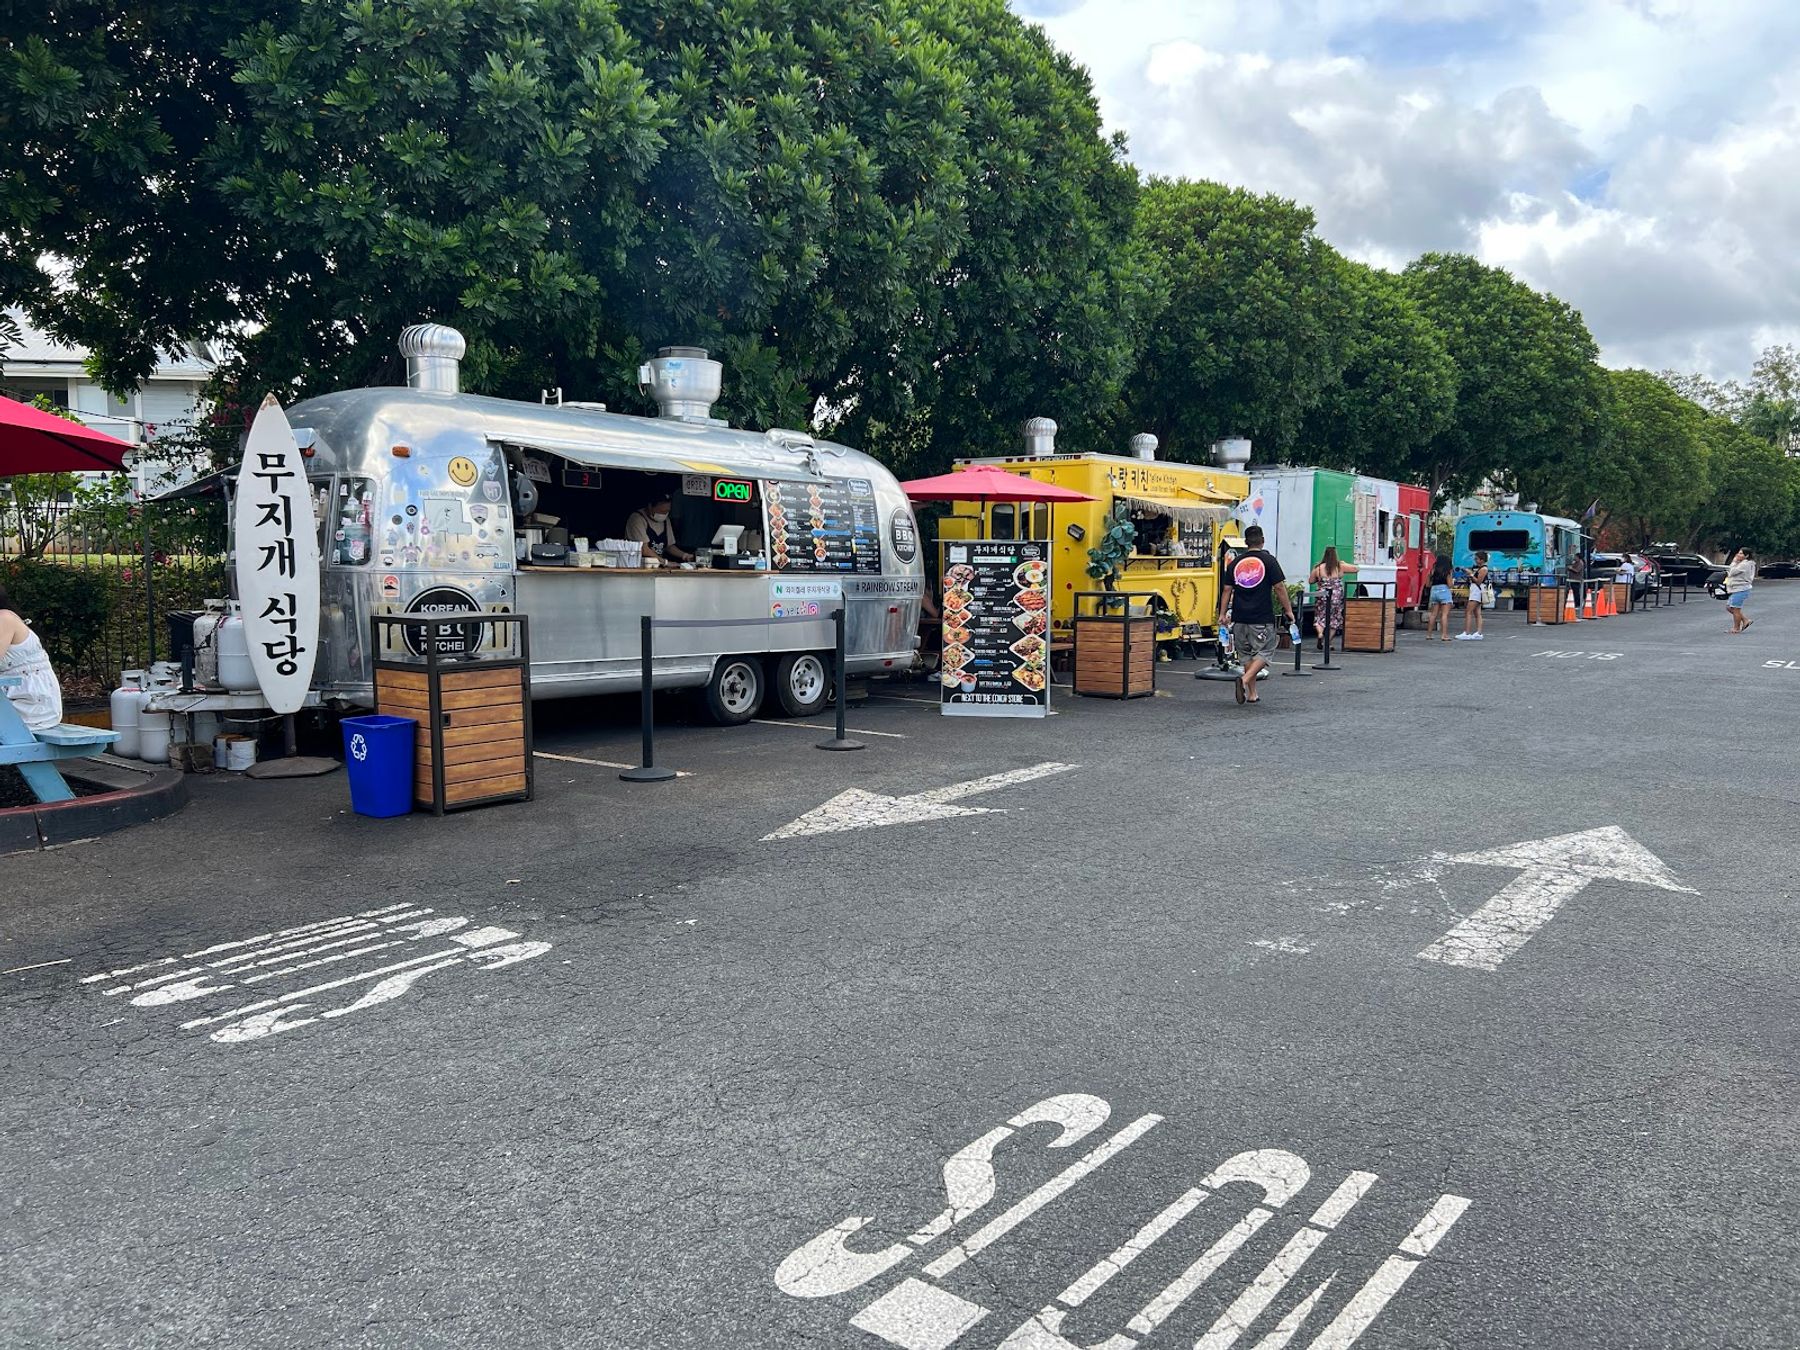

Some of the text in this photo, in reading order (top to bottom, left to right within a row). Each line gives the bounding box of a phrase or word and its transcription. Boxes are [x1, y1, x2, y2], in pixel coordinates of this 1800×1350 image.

[717, 482, 750, 499] OPEN
[861, 581, 894, 594] RAINBOW
[895, 582, 919, 594] STREAM
